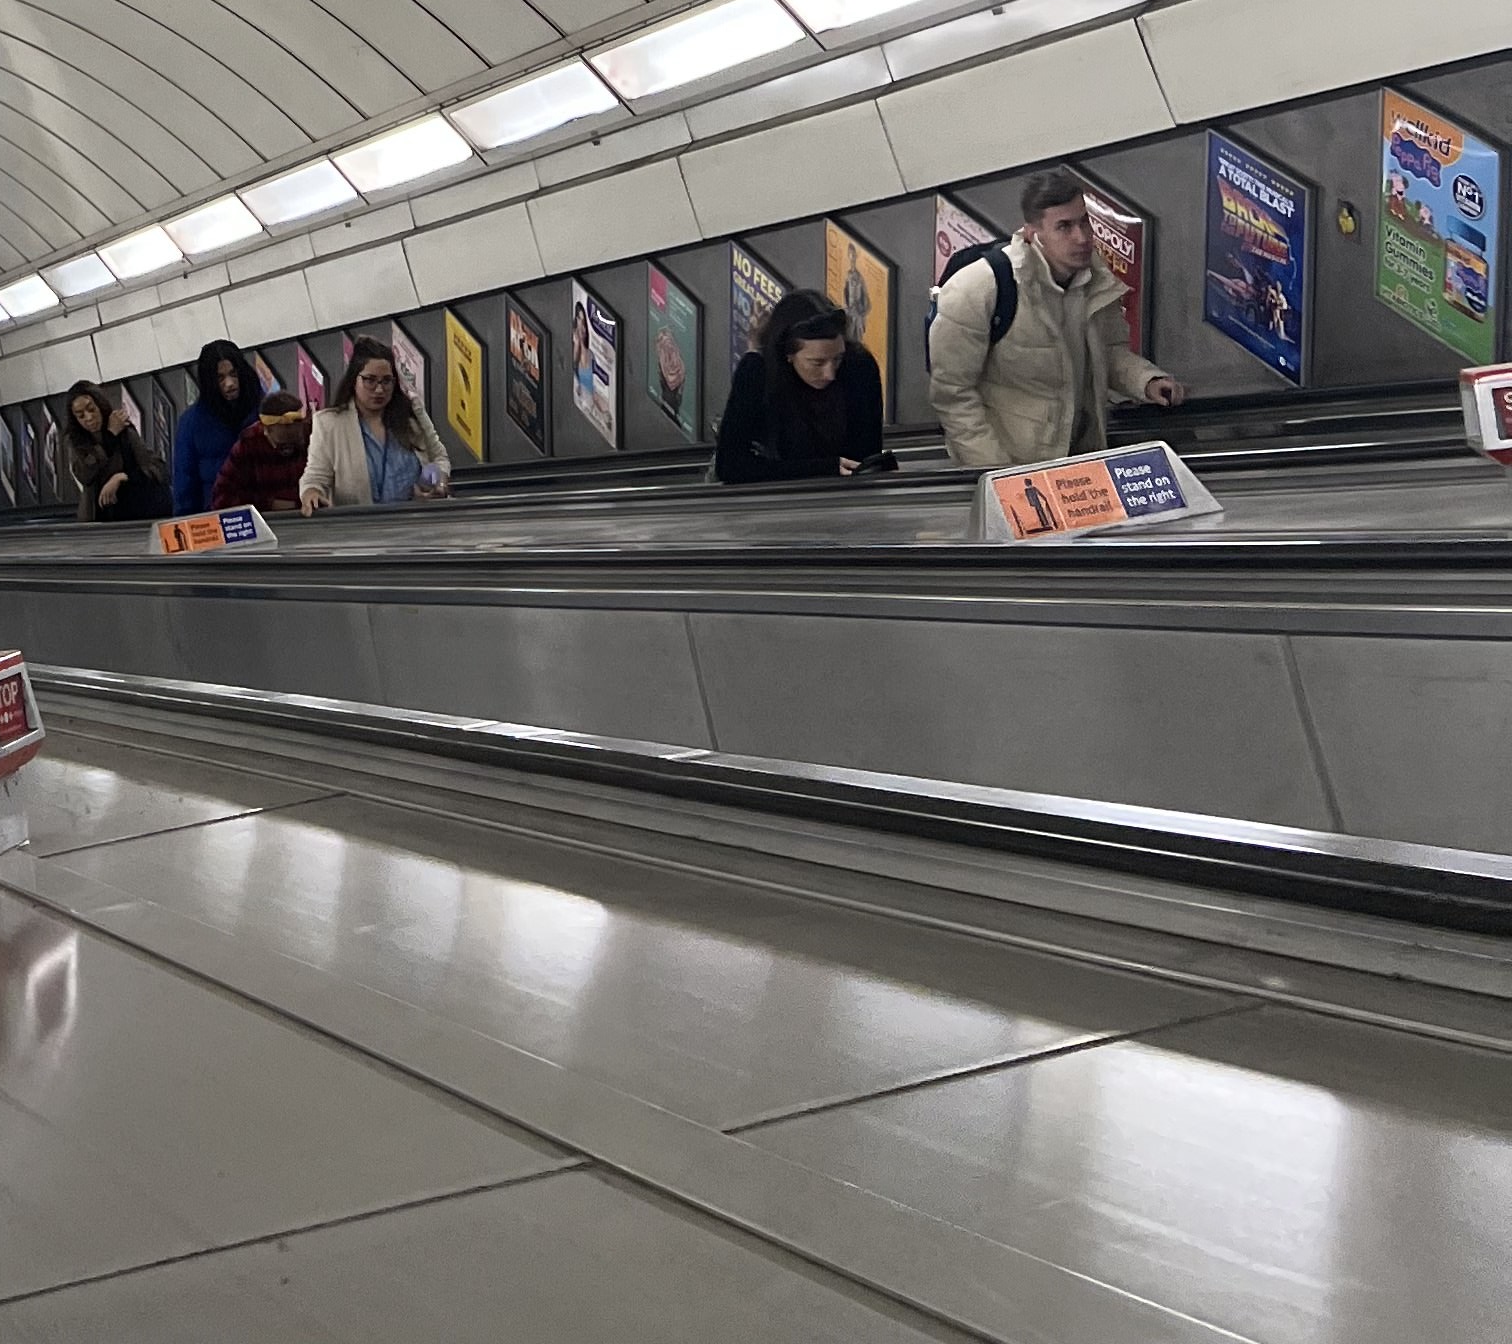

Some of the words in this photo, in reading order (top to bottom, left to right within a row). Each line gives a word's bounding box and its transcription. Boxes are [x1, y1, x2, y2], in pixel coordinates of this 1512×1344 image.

[1218, 164, 1227, 178] A
[1228, 169, 1259, 198] TOTAL
[1259, 189, 1296, 218] BLAST
[1385, 224, 1426, 259] Vitamin
[1384, 241, 1435, 281] Gummies
[732, 247, 752, 278] NO
[754, 267, 782, 303] FEES
[1115, 464, 1151, 480] Please
[1055, 476, 1092, 491] Please
[1121, 478, 1154, 494] stand
[1155, 476, 1171, 487] on
[1061, 490, 1088, 505] hold
[1089, 487, 1109, 499] the
[1126, 494, 1148, 508] the
[1149, 489, 1177, 505] right
[1067, 500, 1114, 518] handrail
